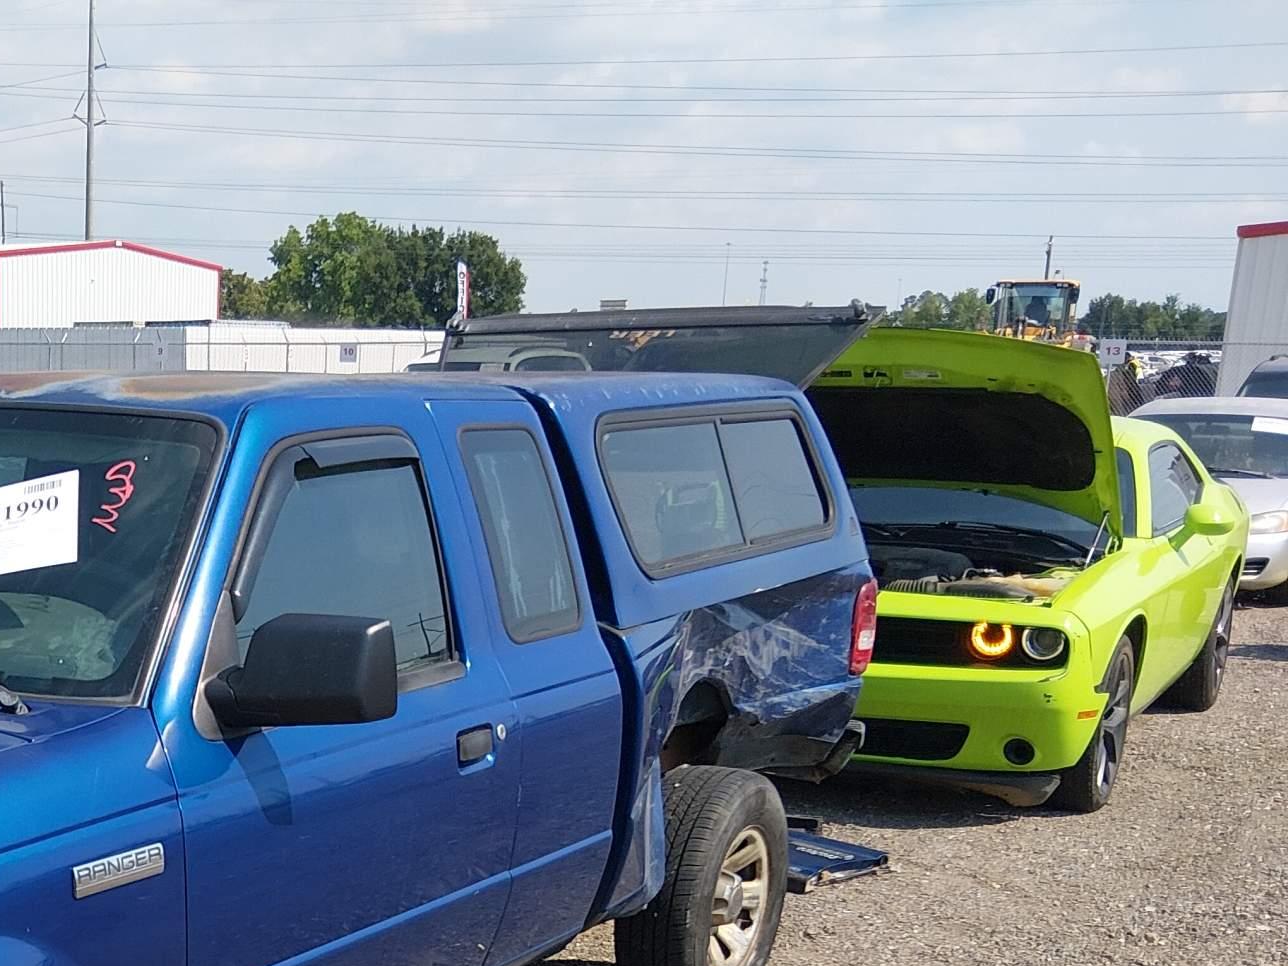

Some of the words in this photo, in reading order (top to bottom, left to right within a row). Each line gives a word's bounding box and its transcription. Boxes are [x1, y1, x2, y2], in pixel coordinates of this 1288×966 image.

[158, 348, 163, 356] 9
[343, 347, 354, 356] 10
[1105, 346, 1121, 356] 13
[76, 846, 163, 885] RANGER
